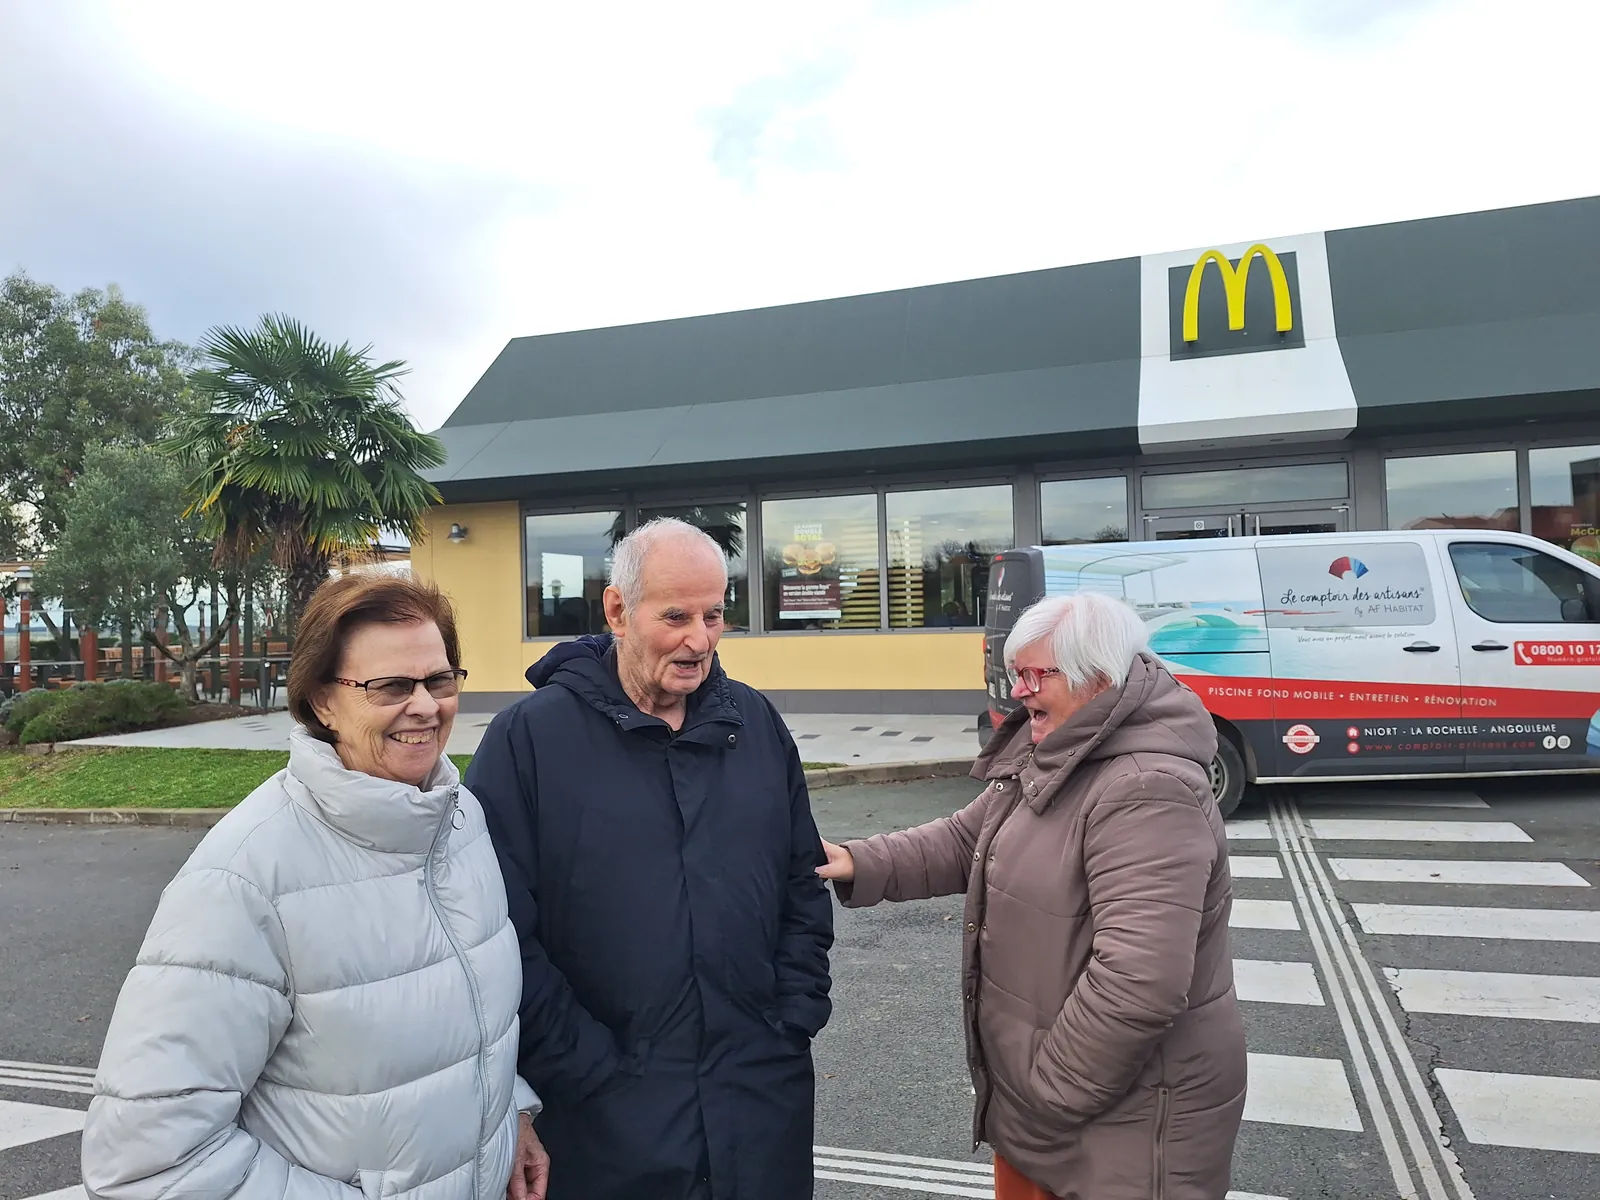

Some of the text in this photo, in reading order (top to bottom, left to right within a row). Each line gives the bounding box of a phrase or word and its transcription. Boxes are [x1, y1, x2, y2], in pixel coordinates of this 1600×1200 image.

[1280, 588, 1297, 606] Le
[1300, 588, 1349, 606] comptoir
[1352, 586, 1371, 600] des
[1368, 604, 1381, 613] AF
[1384, 604, 1425, 613] HABITAT
[1531, 644, 1564, 656] 0800
[1568, 644, 1585, 656] 10
[1208, 687, 1497, 707] PISCINE FOND MOBILE ENTRETIEN RÉNOVATION
[1364, 723, 1557, 736] NIORT LA ROCHELLE ANGOULEME
